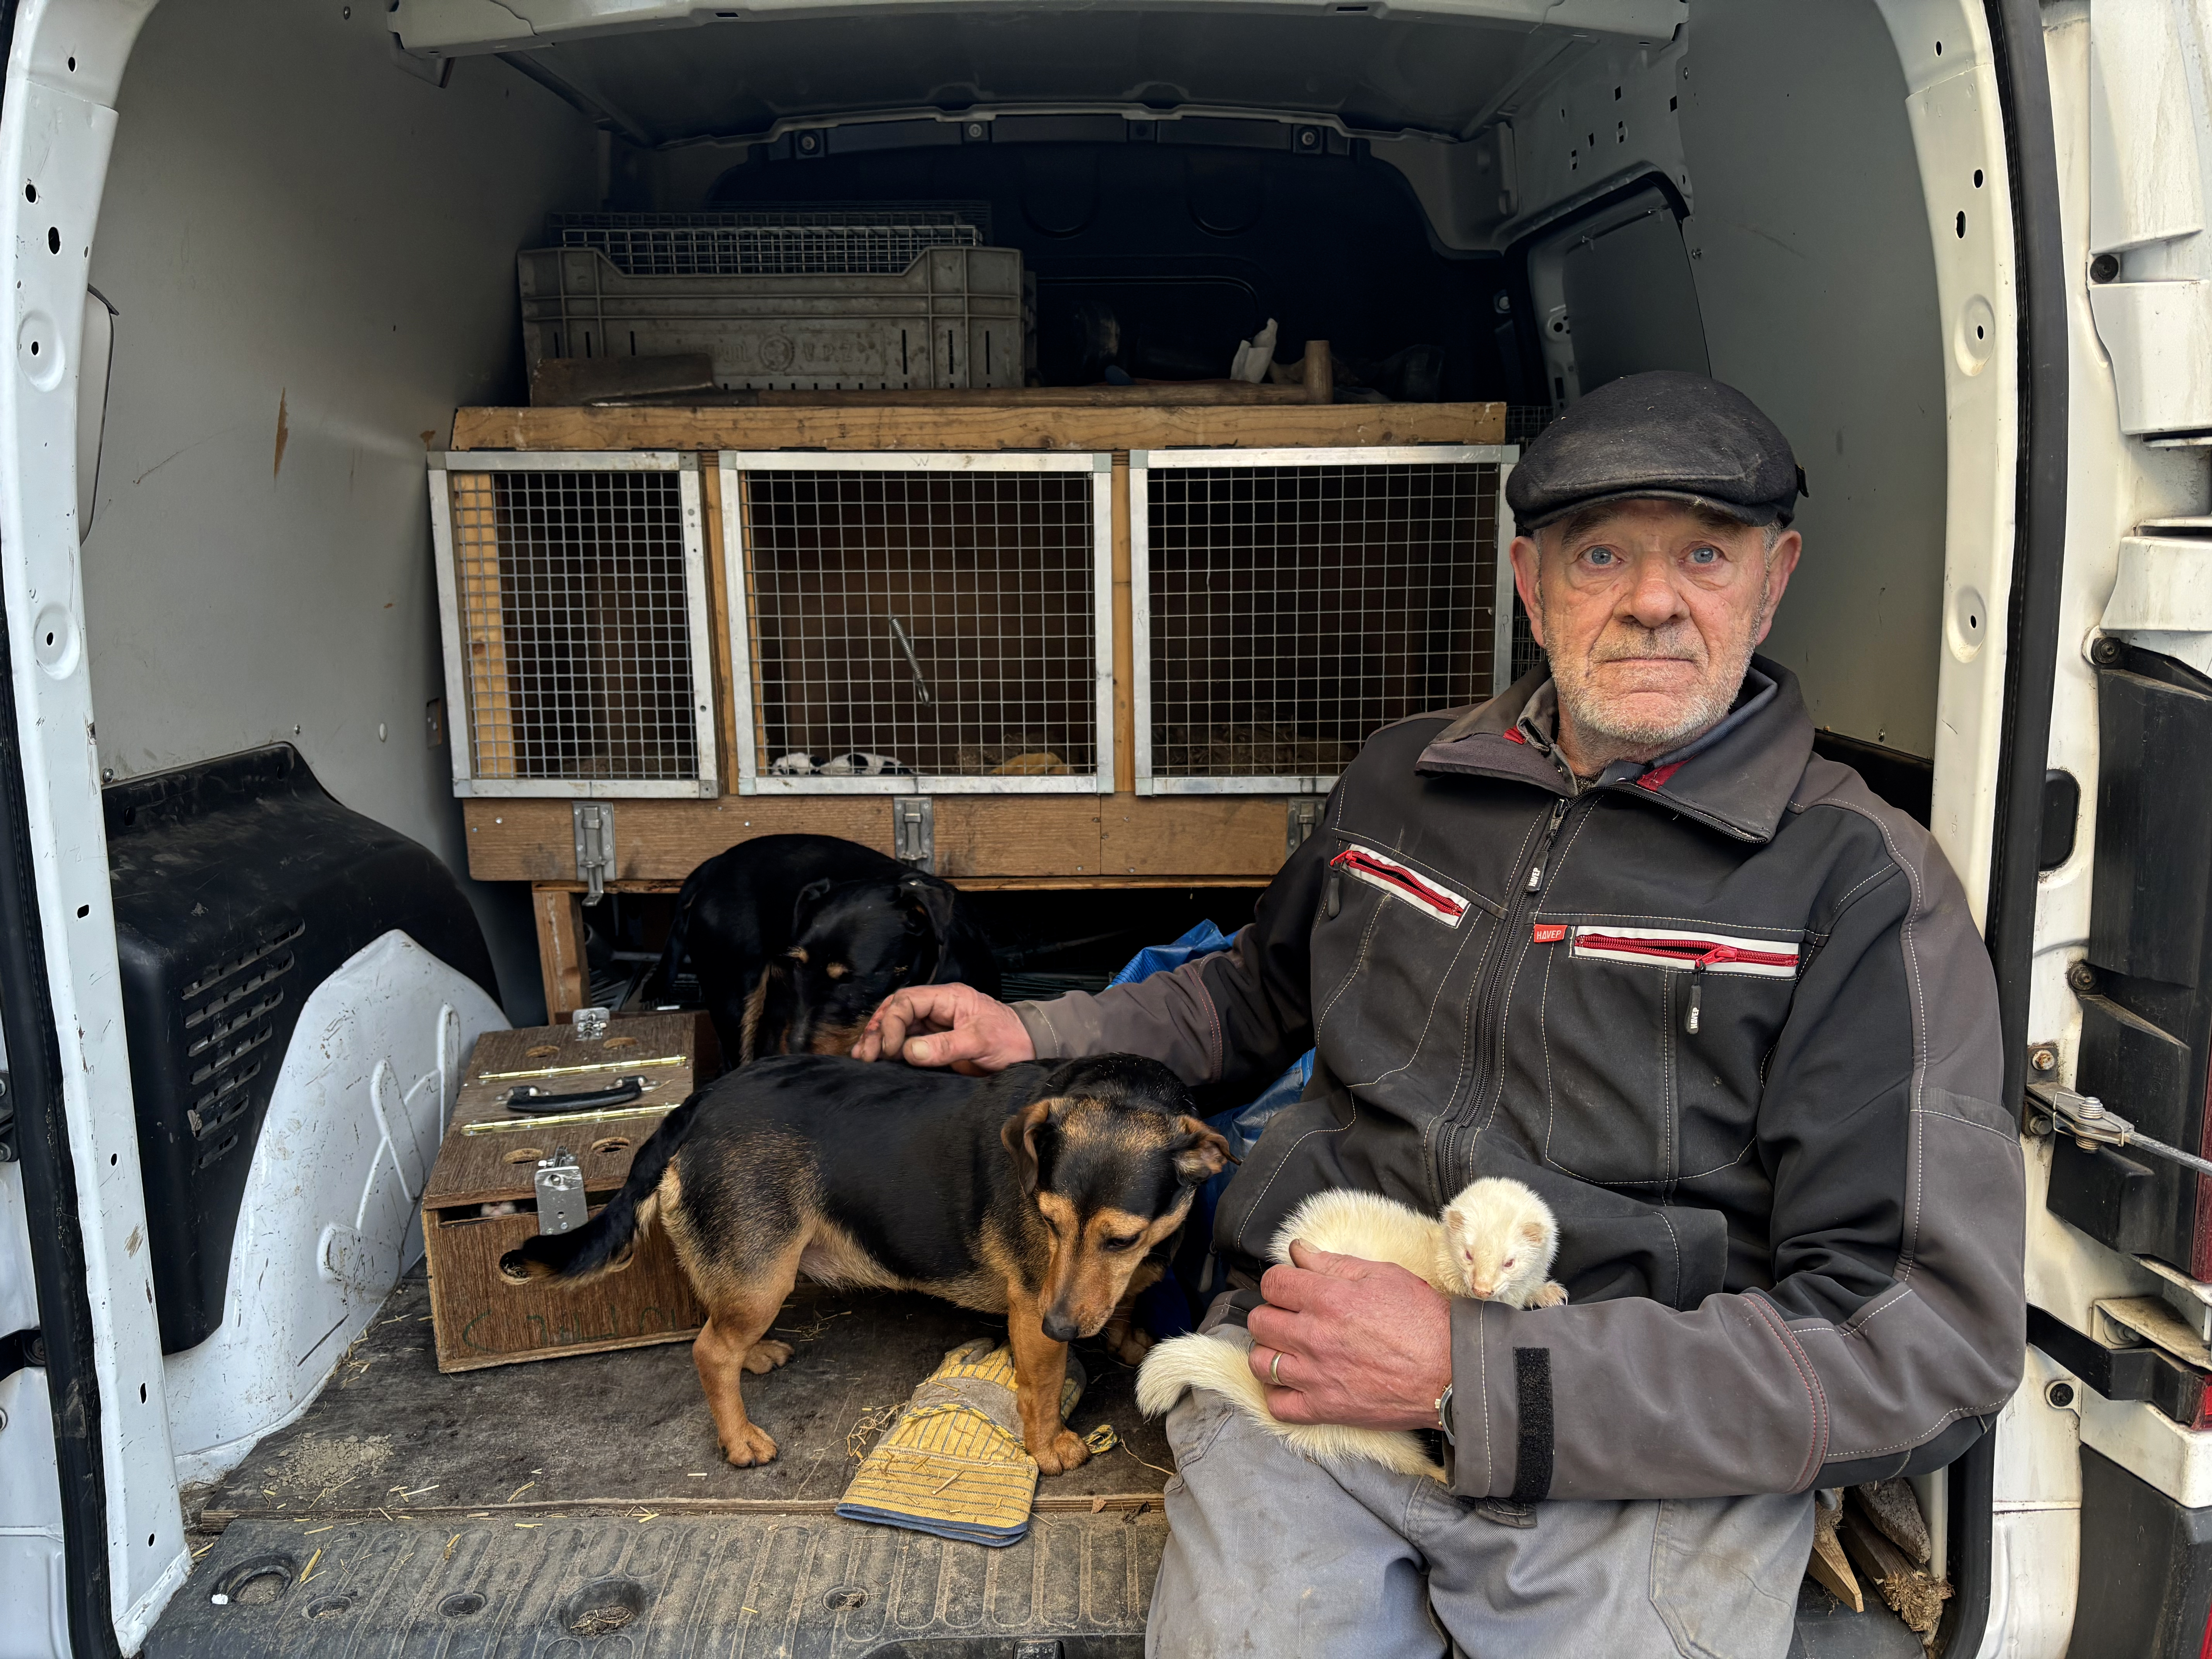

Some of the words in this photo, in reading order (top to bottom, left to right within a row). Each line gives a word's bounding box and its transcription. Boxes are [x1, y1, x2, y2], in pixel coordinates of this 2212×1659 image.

[1528, 867, 1540, 887] HAVEP
[1537, 930, 1561, 940] HAVEP
[1690, 1007, 1699, 1029] HAVEP
